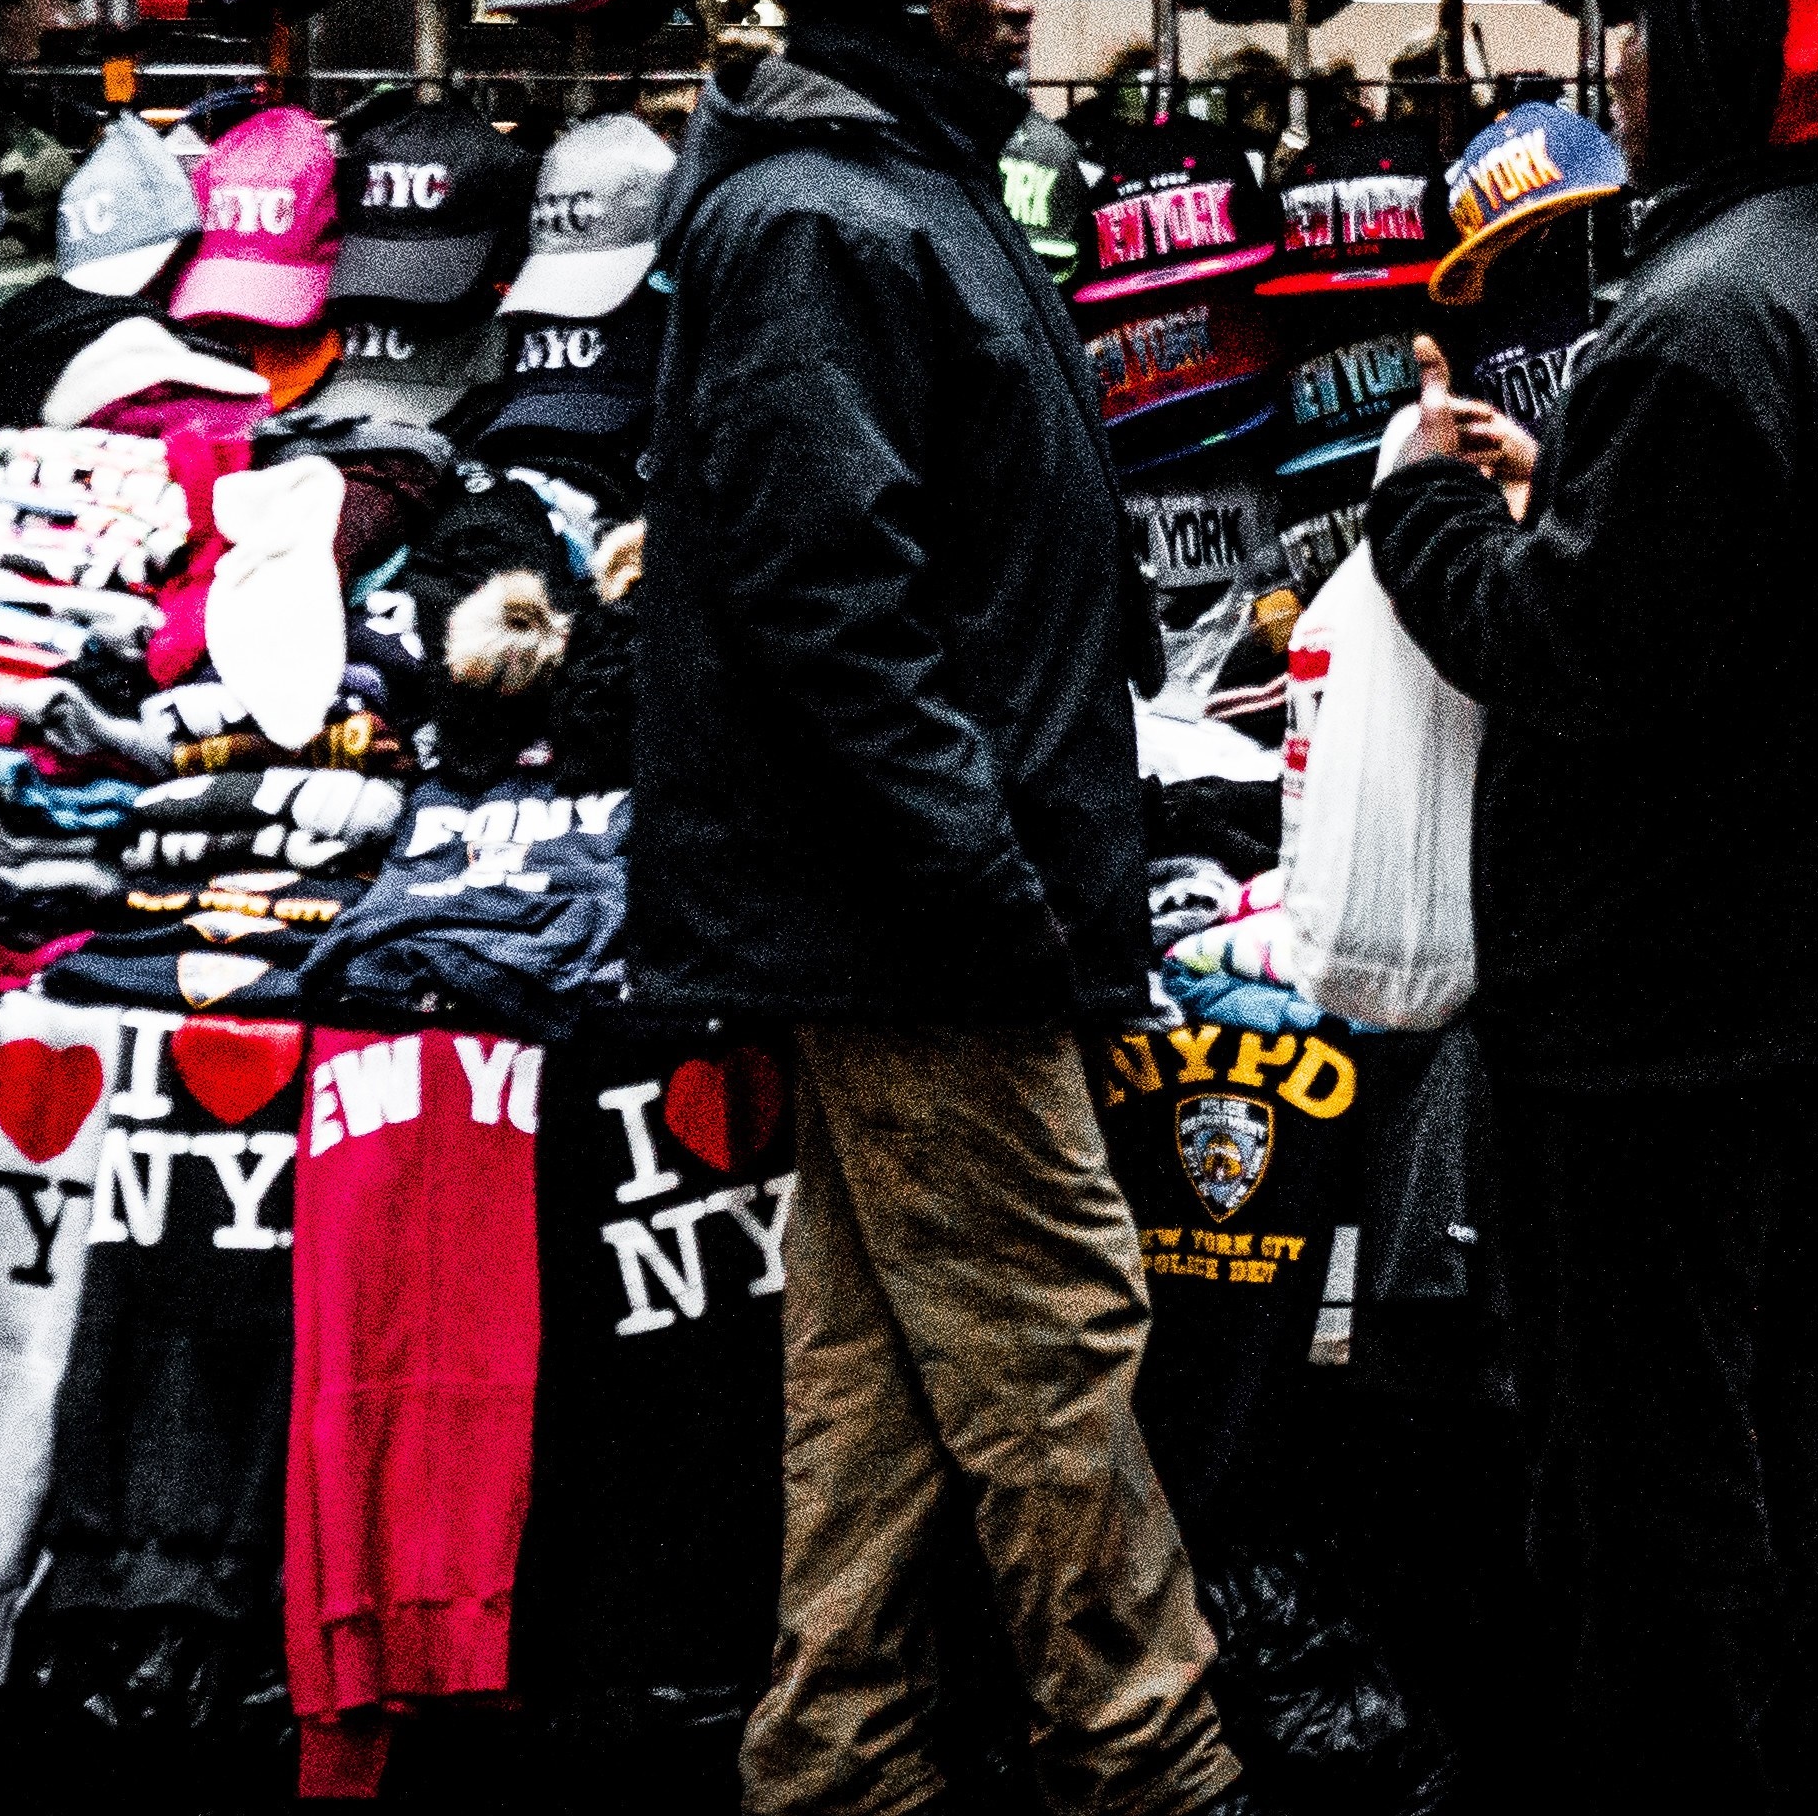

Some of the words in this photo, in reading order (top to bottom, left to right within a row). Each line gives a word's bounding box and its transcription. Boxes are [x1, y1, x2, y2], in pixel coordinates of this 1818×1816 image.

[362, 162, 452, 210] NYC
[1336, 177, 1428, 242] YORK
[1472, 130, 1562, 209] YORK
[1146, 178, 1238, 257] YORK
[516, 327, 606, 373] NYC
[1160, 505, 1248, 568] YORK
[109, 1012, 186, 1121] I
[453, 1035, 544, 1135] YO
[1103, 1023, 1359, 1121] NYPD
[597, 1080, 680, 1203] I
[88, 1131, 295, 1249] NY
[601, 1171, 800, 1337] NY
